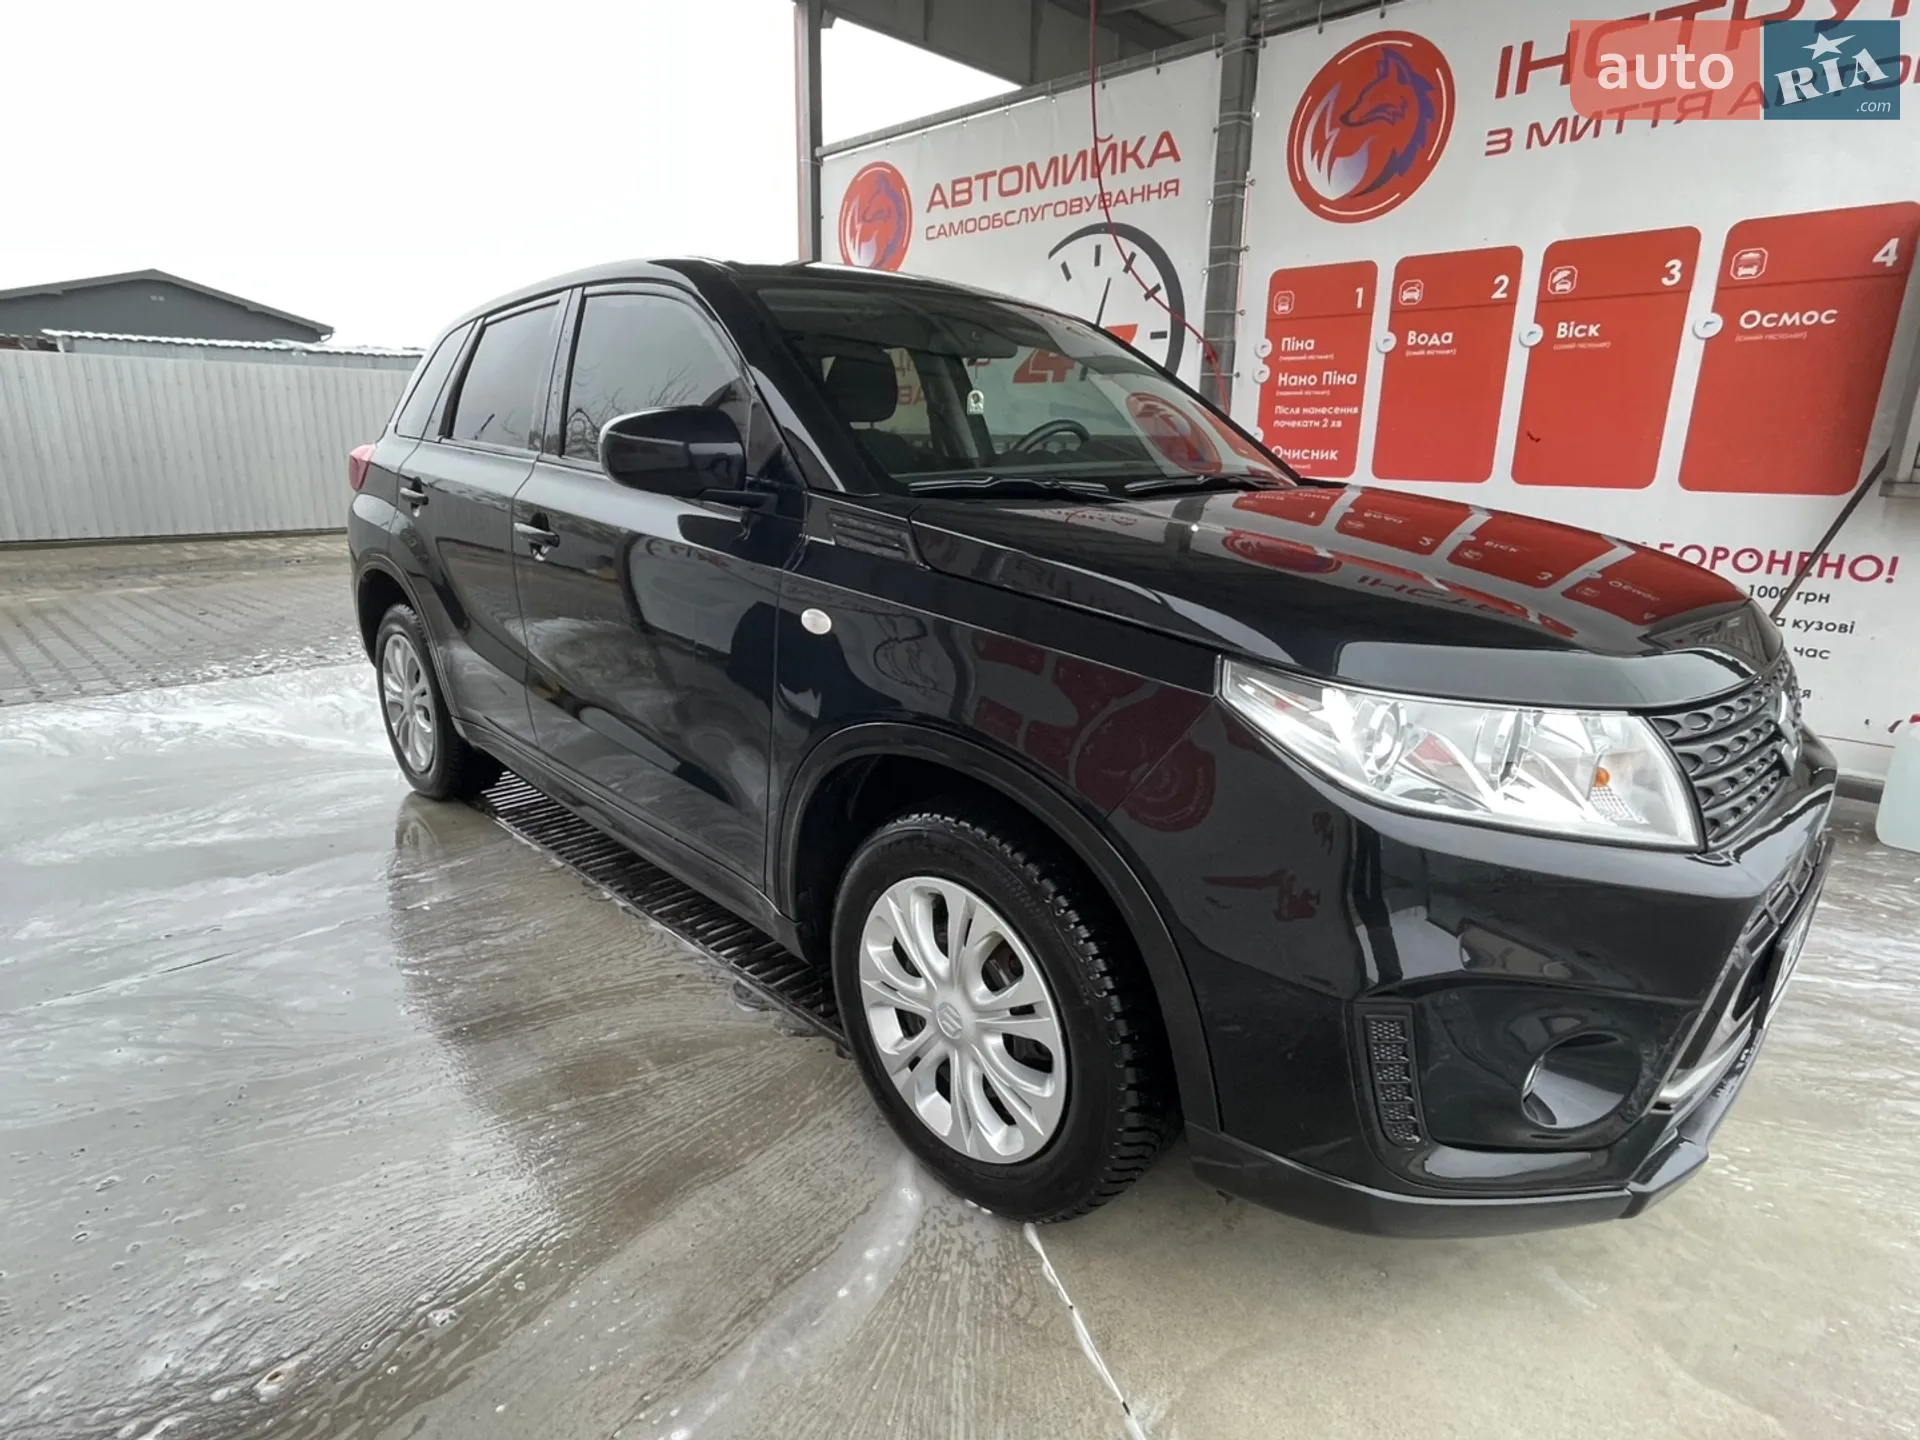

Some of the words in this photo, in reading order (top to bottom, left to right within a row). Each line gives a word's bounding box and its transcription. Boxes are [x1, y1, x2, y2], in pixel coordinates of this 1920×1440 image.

[1495, 0, 1911, 99] ІНСТРУ
[926, 130, 1181, 213] АВТОМИЙКА
[925, 178, 1180, 241] САМООБСЛУГОВУВАННЯ
[1872, 238, 1900, 267] 4
[1661, 259, 1682, 286] 3
[1491, 275, 1509, 299] 2
[1355, 287, 1364, 309] 1
[1739, 309, 1838, 329] Осмос
[1407, 330, 1453, 346] Вода
[1556, 321, 1601, 339] Віск
[1281, 336, 1315, 352] Піна
[1278, 372, 1318, 387] Нано
[1322, 370, 1358, 386] Піна
[1271, 445, 1339, 461] Очисник
[1796, 591, 1831, 604] грн
[1792, 618, 1855, 634] кузові
[1793, 646, 1831, 659] час
